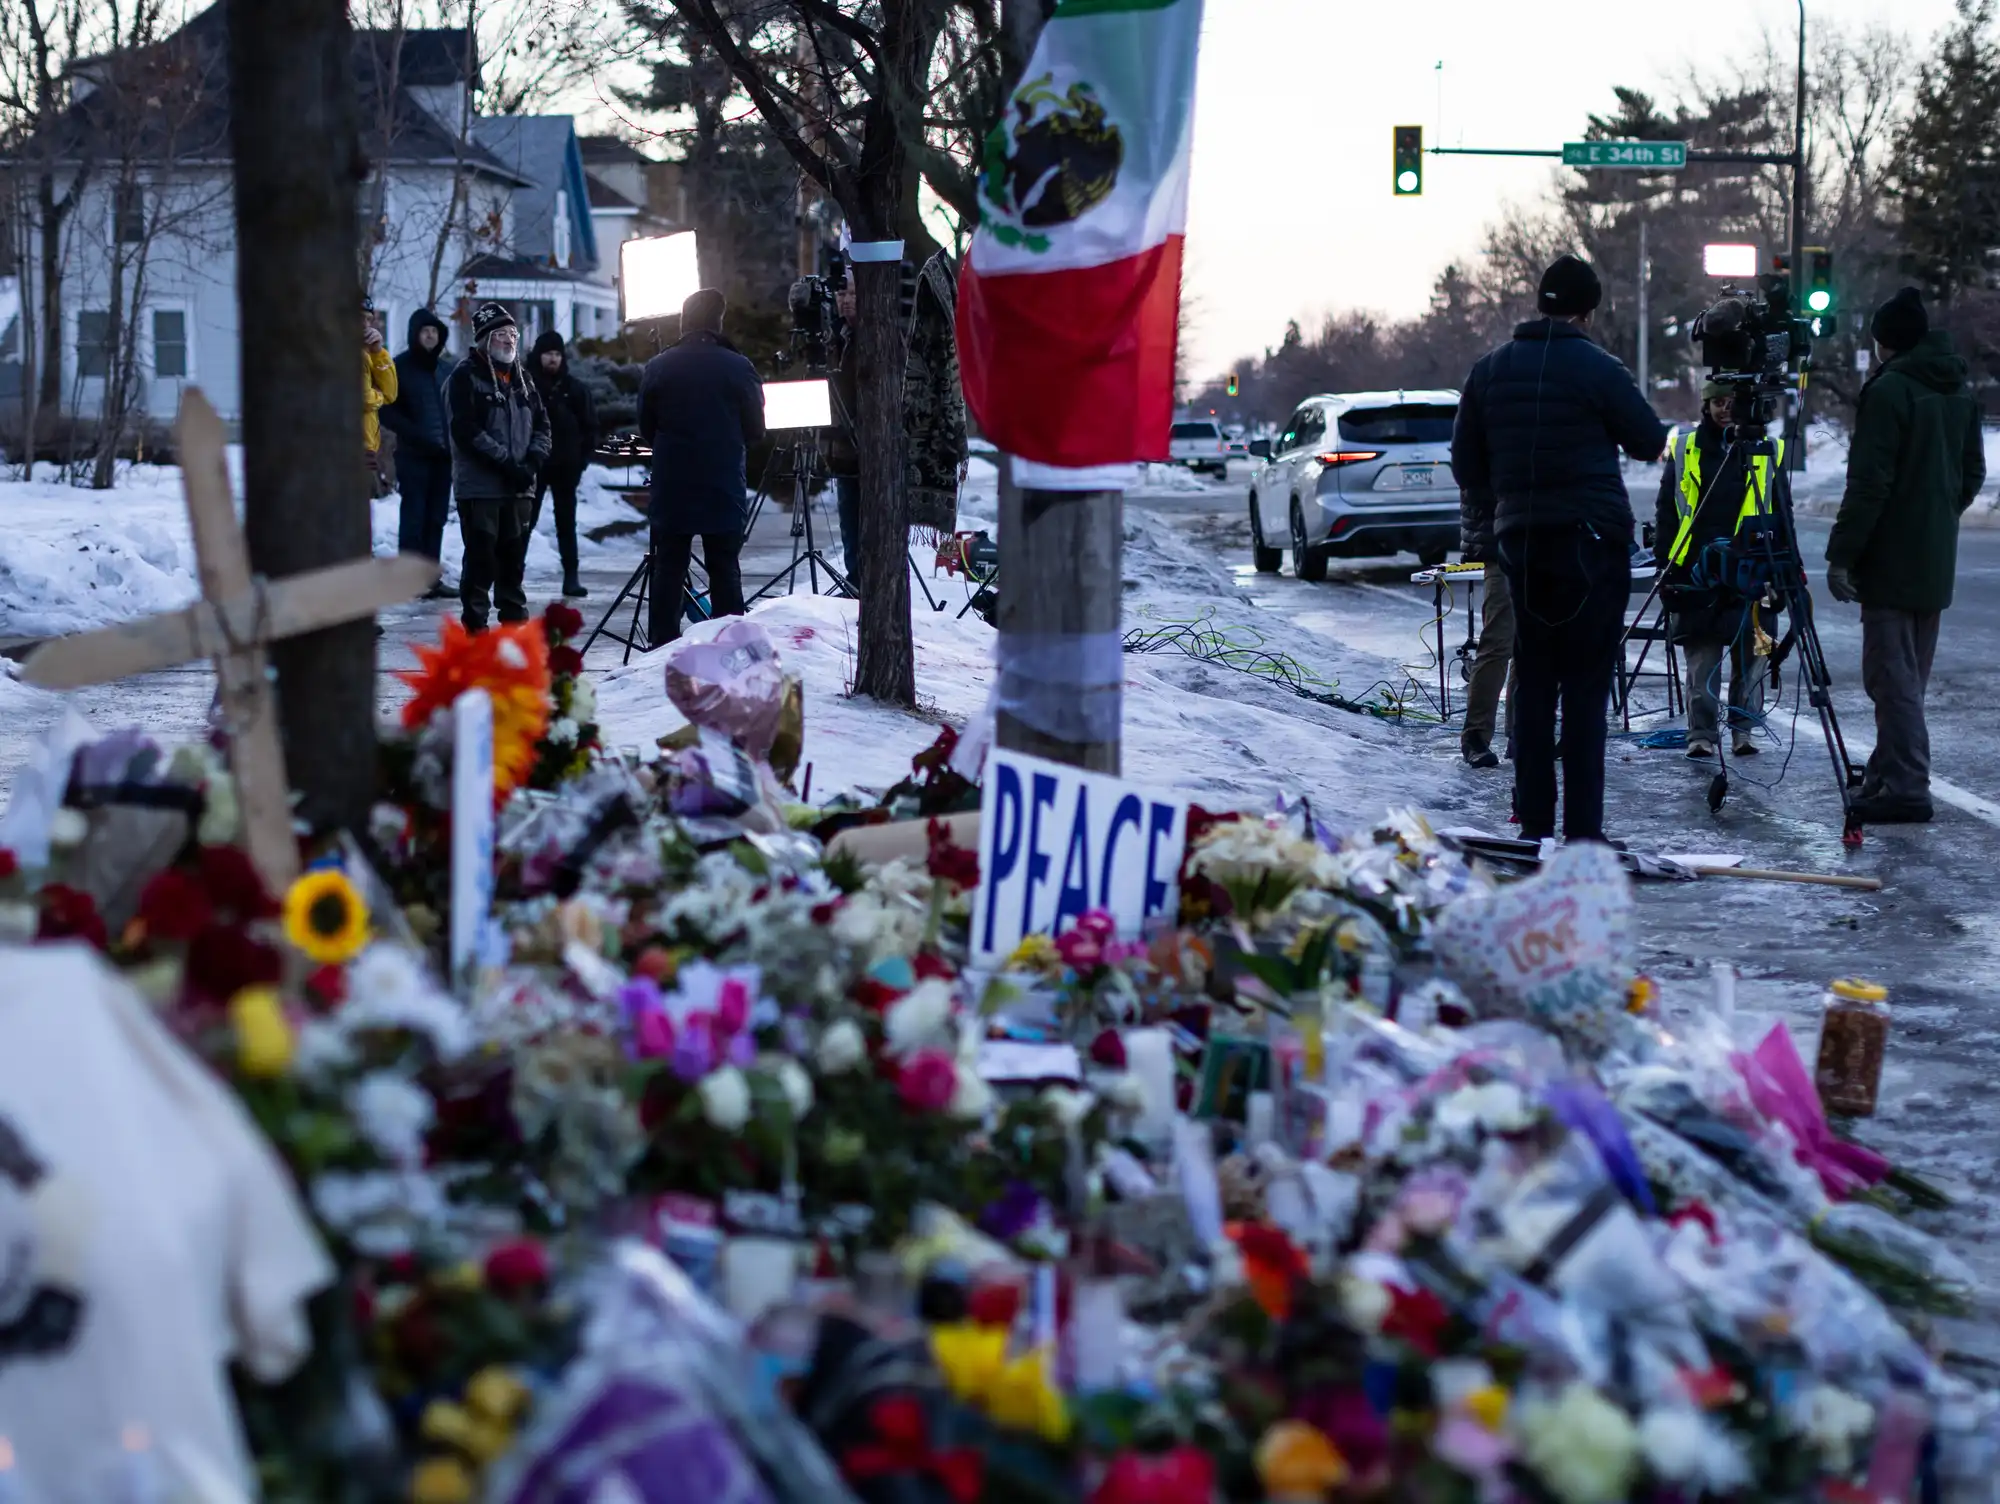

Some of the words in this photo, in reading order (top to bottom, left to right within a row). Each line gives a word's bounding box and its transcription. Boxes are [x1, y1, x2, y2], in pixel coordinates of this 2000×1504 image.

[1590, 148, 1601, 162] E
[1608, 147, 1655, 162] 34th
[1660, 148, 1682, 162] St
[983, 764, 1175, 953] PEACE
